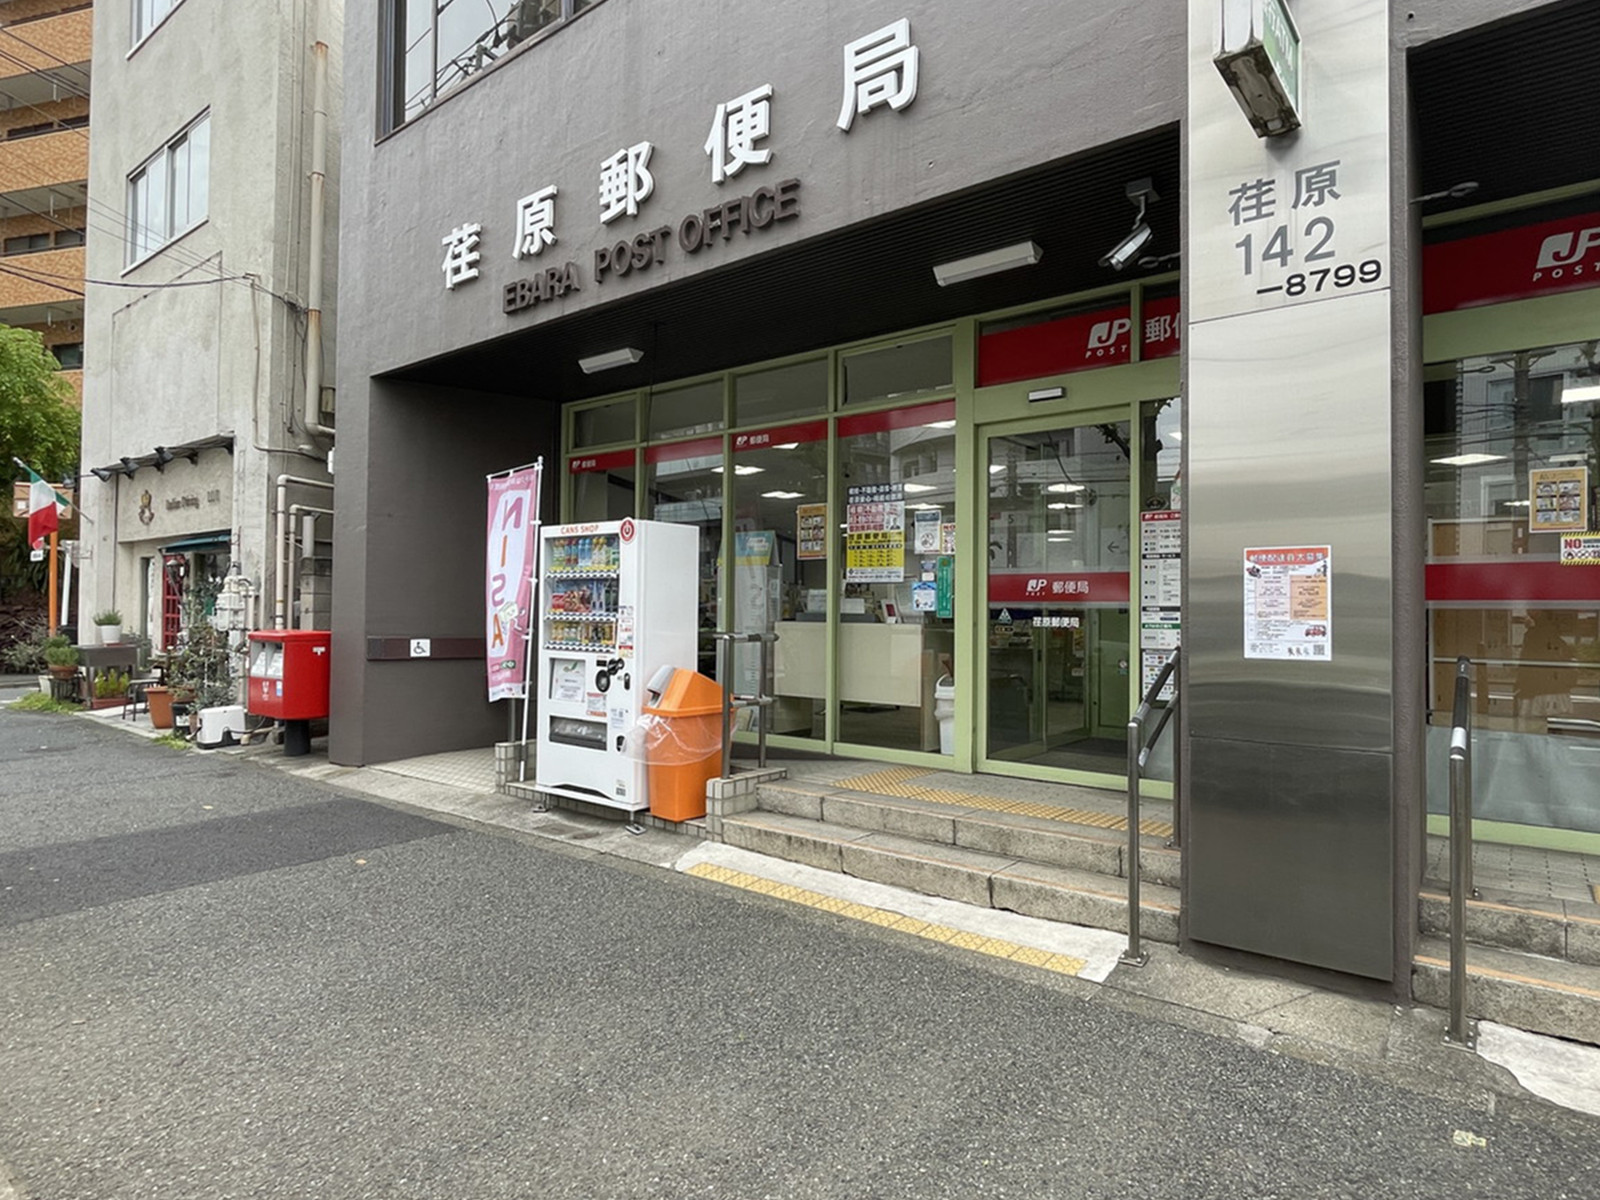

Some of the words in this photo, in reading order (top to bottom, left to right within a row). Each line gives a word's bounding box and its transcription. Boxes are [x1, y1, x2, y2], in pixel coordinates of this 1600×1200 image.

[441, 17, 920, 290] 荏原郵便局
[1227, 159, 1342, 227] 荏原
[502, 261, 581, 315] EBARA
[594, 224, 673, 284] POST
[678, 177, 801, 255] OFFICE
[1234, 215, 1336, 277] 142
[1532, 262, 1600, 282] POST
[1087, 317, 1131, 350] JP
[1085, 344, 1128, 359] POST
[560, 525, 579, 536] CANS
[580, 524, 599, 534] SHOP
[1564, 538, 1582, 549] NO
[1052, 580, 1089, 595] 郵便局
